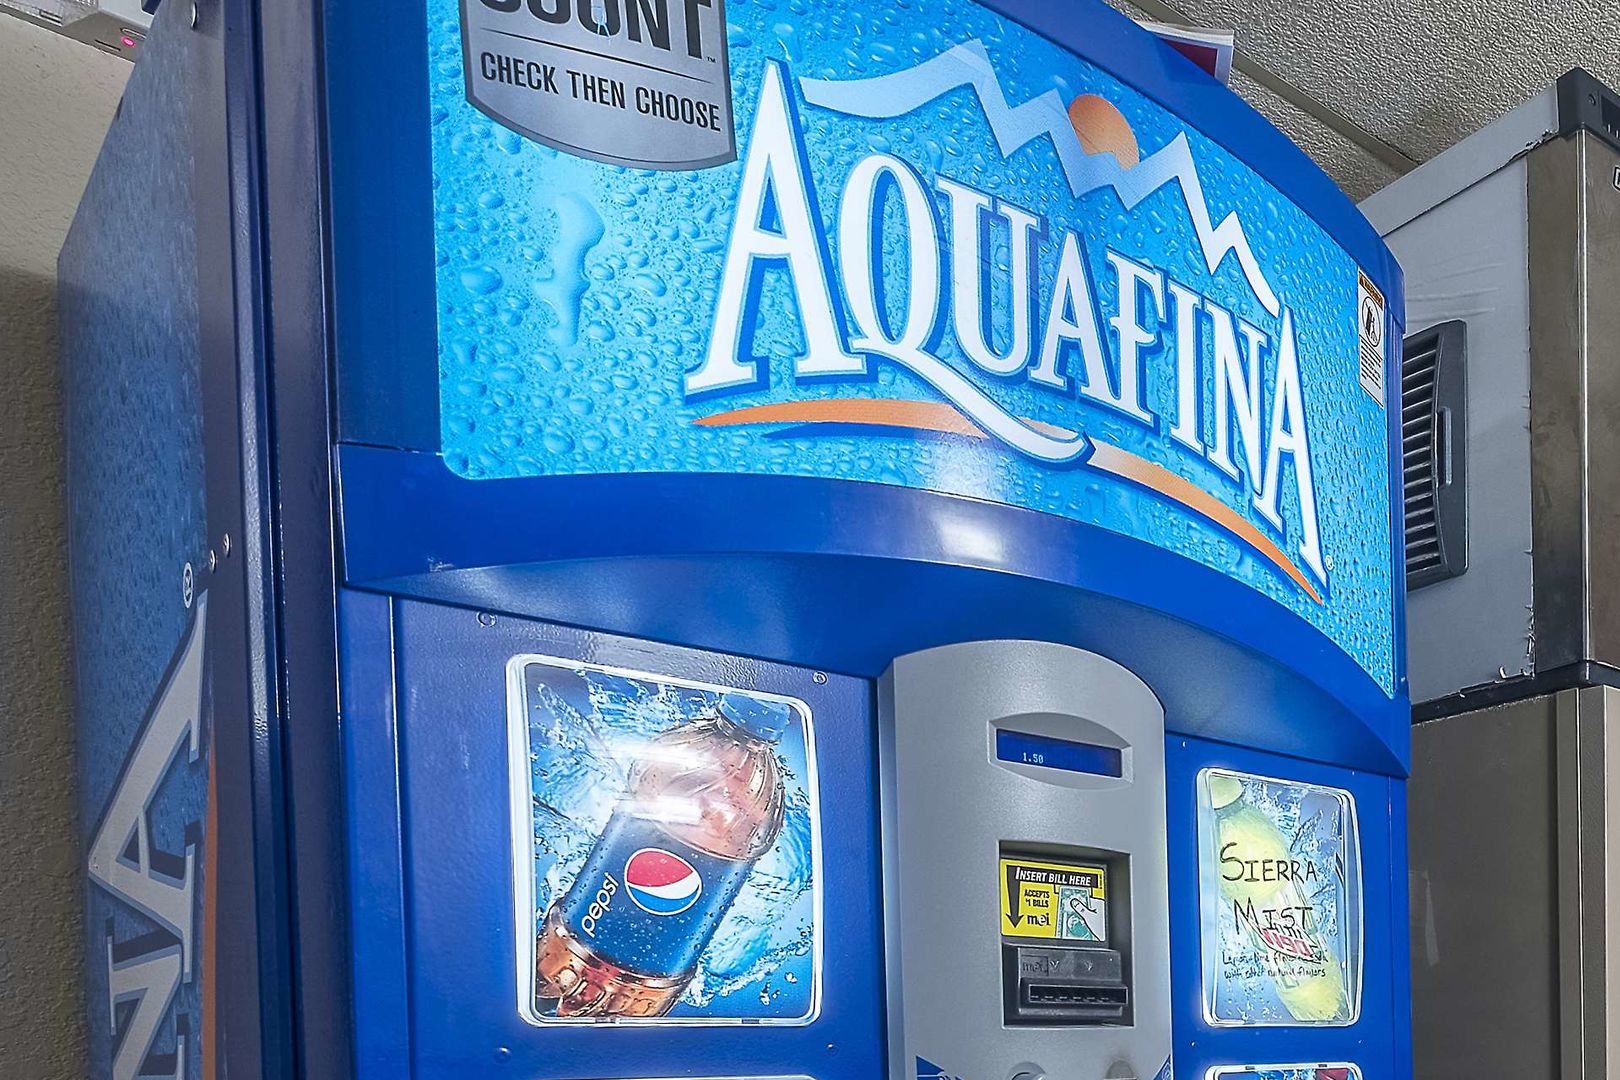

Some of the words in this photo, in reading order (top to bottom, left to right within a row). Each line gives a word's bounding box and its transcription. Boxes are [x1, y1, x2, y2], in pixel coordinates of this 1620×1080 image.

[479, 0, 711, 59] UNT
[480, 51, 560, 95] CHECK
[566, 69, 627, 110] THEN
[635, 86, 722, 132] CHOOSE
[685, 57, 1329, 590] AQUAFINA
[1022, 752, 1044, 764] 1.50
[1015, 866, 1050, 883] INSERT
[1048, 872, 1068, 885] BILL
[1069, 874, 1092, 887] HERE
[1219, 842, 1318, 884] SIERRA
[580, 872, 620, 938] pepsi
[1026, 912, 1050, 926] mei
[1233, 896, 1313, 936] MIST
